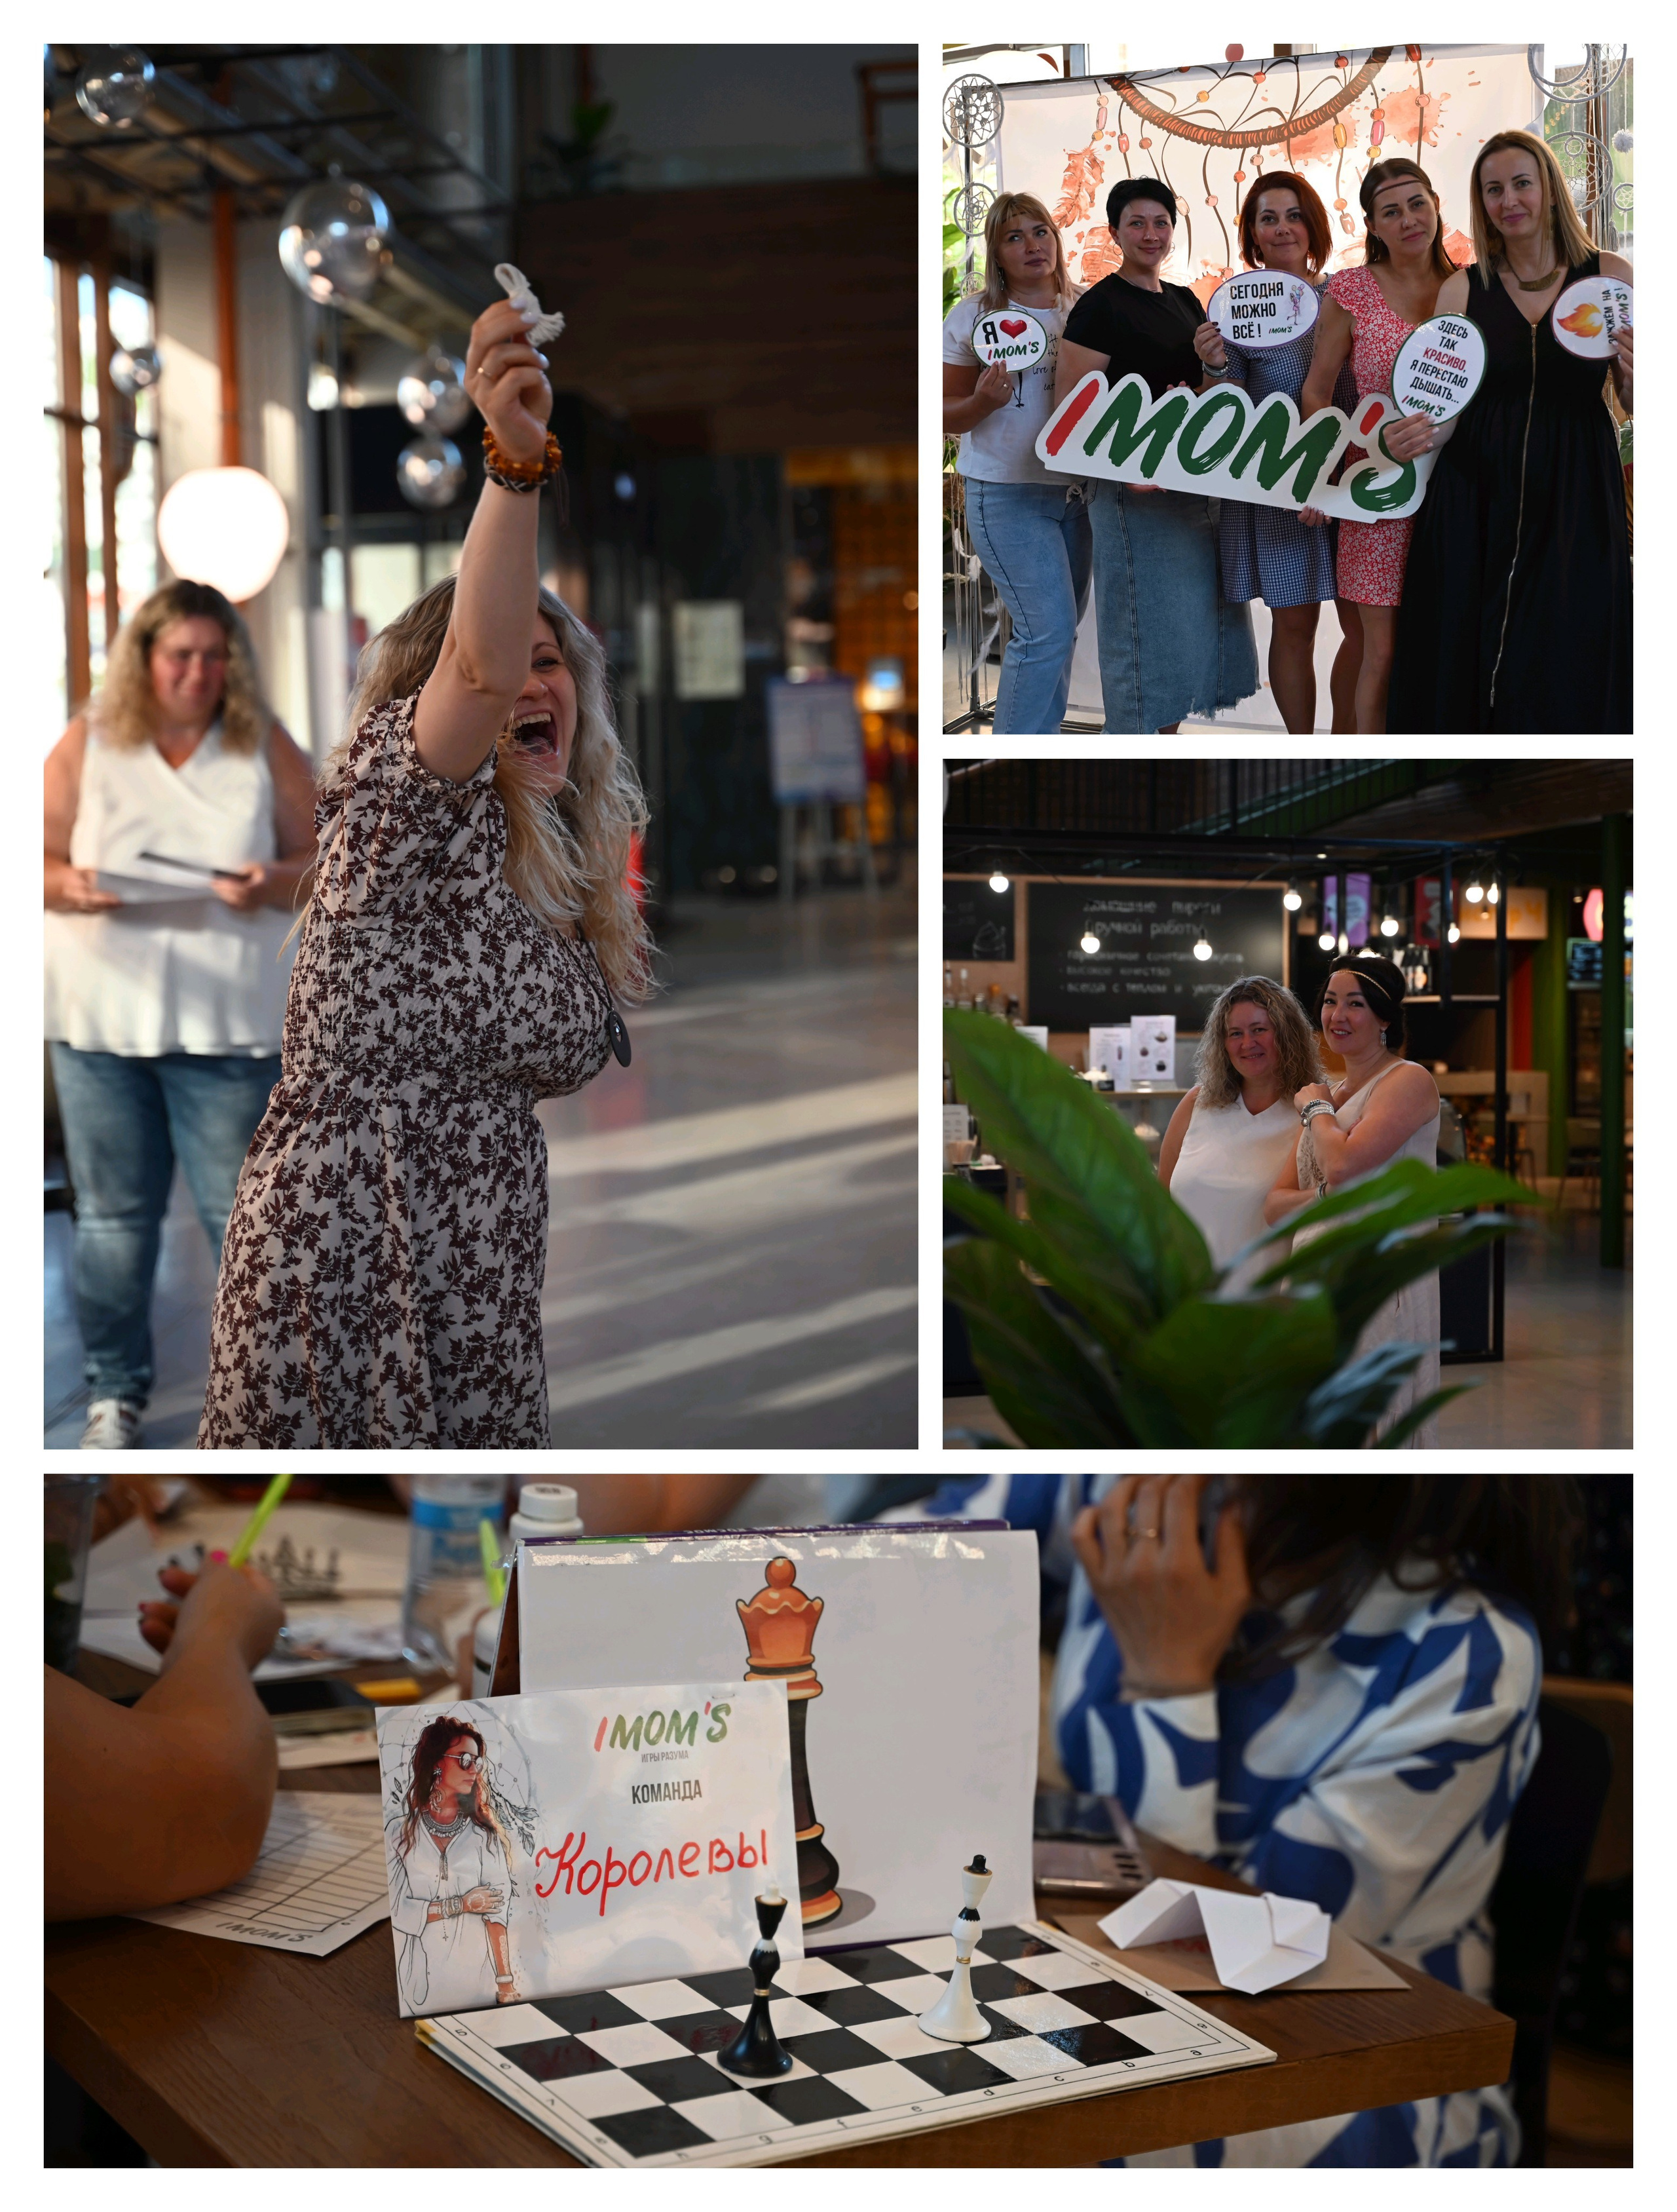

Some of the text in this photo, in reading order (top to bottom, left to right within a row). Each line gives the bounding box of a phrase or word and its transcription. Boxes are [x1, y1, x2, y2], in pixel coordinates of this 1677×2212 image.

[1230, 282, 1283, 299] СЕГОДНЯ
[1602, 290, 1611, 301] НА
[1232, 302, 1276, 319] МОЖНО
[983, 321, 999, 345] Я
[1438, 320, 1468, 339] ЗДЕСЬ
[1439, 336, 1458, 351] ТАК
[1423, 347, 1466, 373] КРАСИВО,
[1410, 360, 1468, 388] Я ПЕРЕСТАЮ
[1410, 377, 1459, 404] ДЫШАТЬ...
[641, 1750, 688, 1763] ИГРЫ РАЗУМА
[632, 1780, 702, 1804] КОМАНДА
[535, 1829, 768, 1916] Королевы
